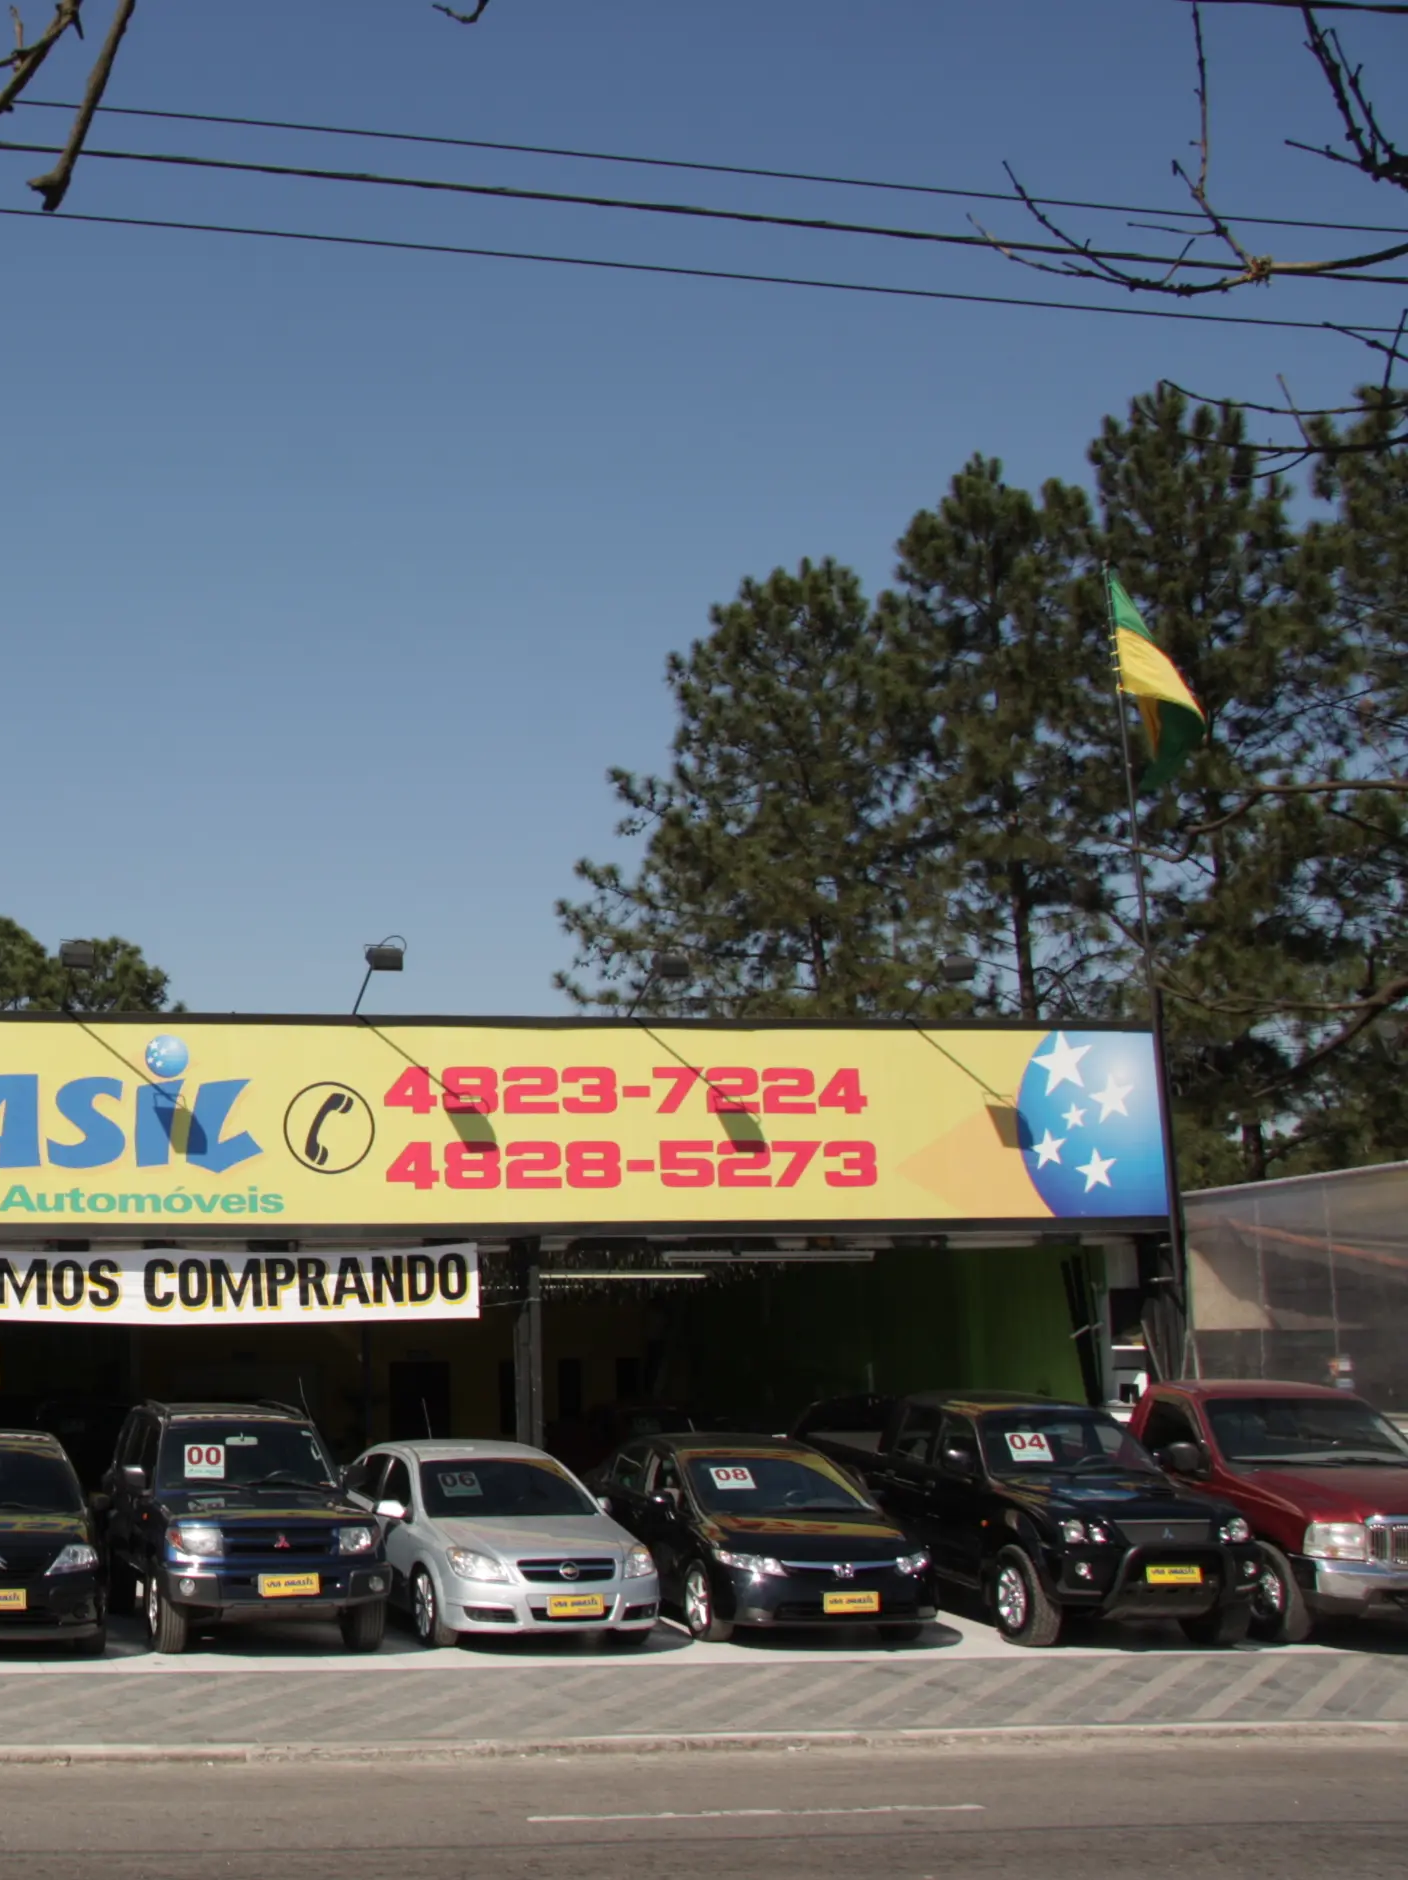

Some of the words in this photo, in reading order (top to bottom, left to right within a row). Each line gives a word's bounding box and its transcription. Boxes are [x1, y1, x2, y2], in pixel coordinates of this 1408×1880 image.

[383, 1066, 868, 1115] 4823-7224
[386, 1140, 878, 1190] 4828-5273
[144, 1252, 473, 1314] COMPRANDO
[1008, 1433, 1046, 1451] 04
[187, 1446, 222, 1466] 00
[441, 1473, 478, 1489] 06
[713, 1467, 749, 1481] 08
